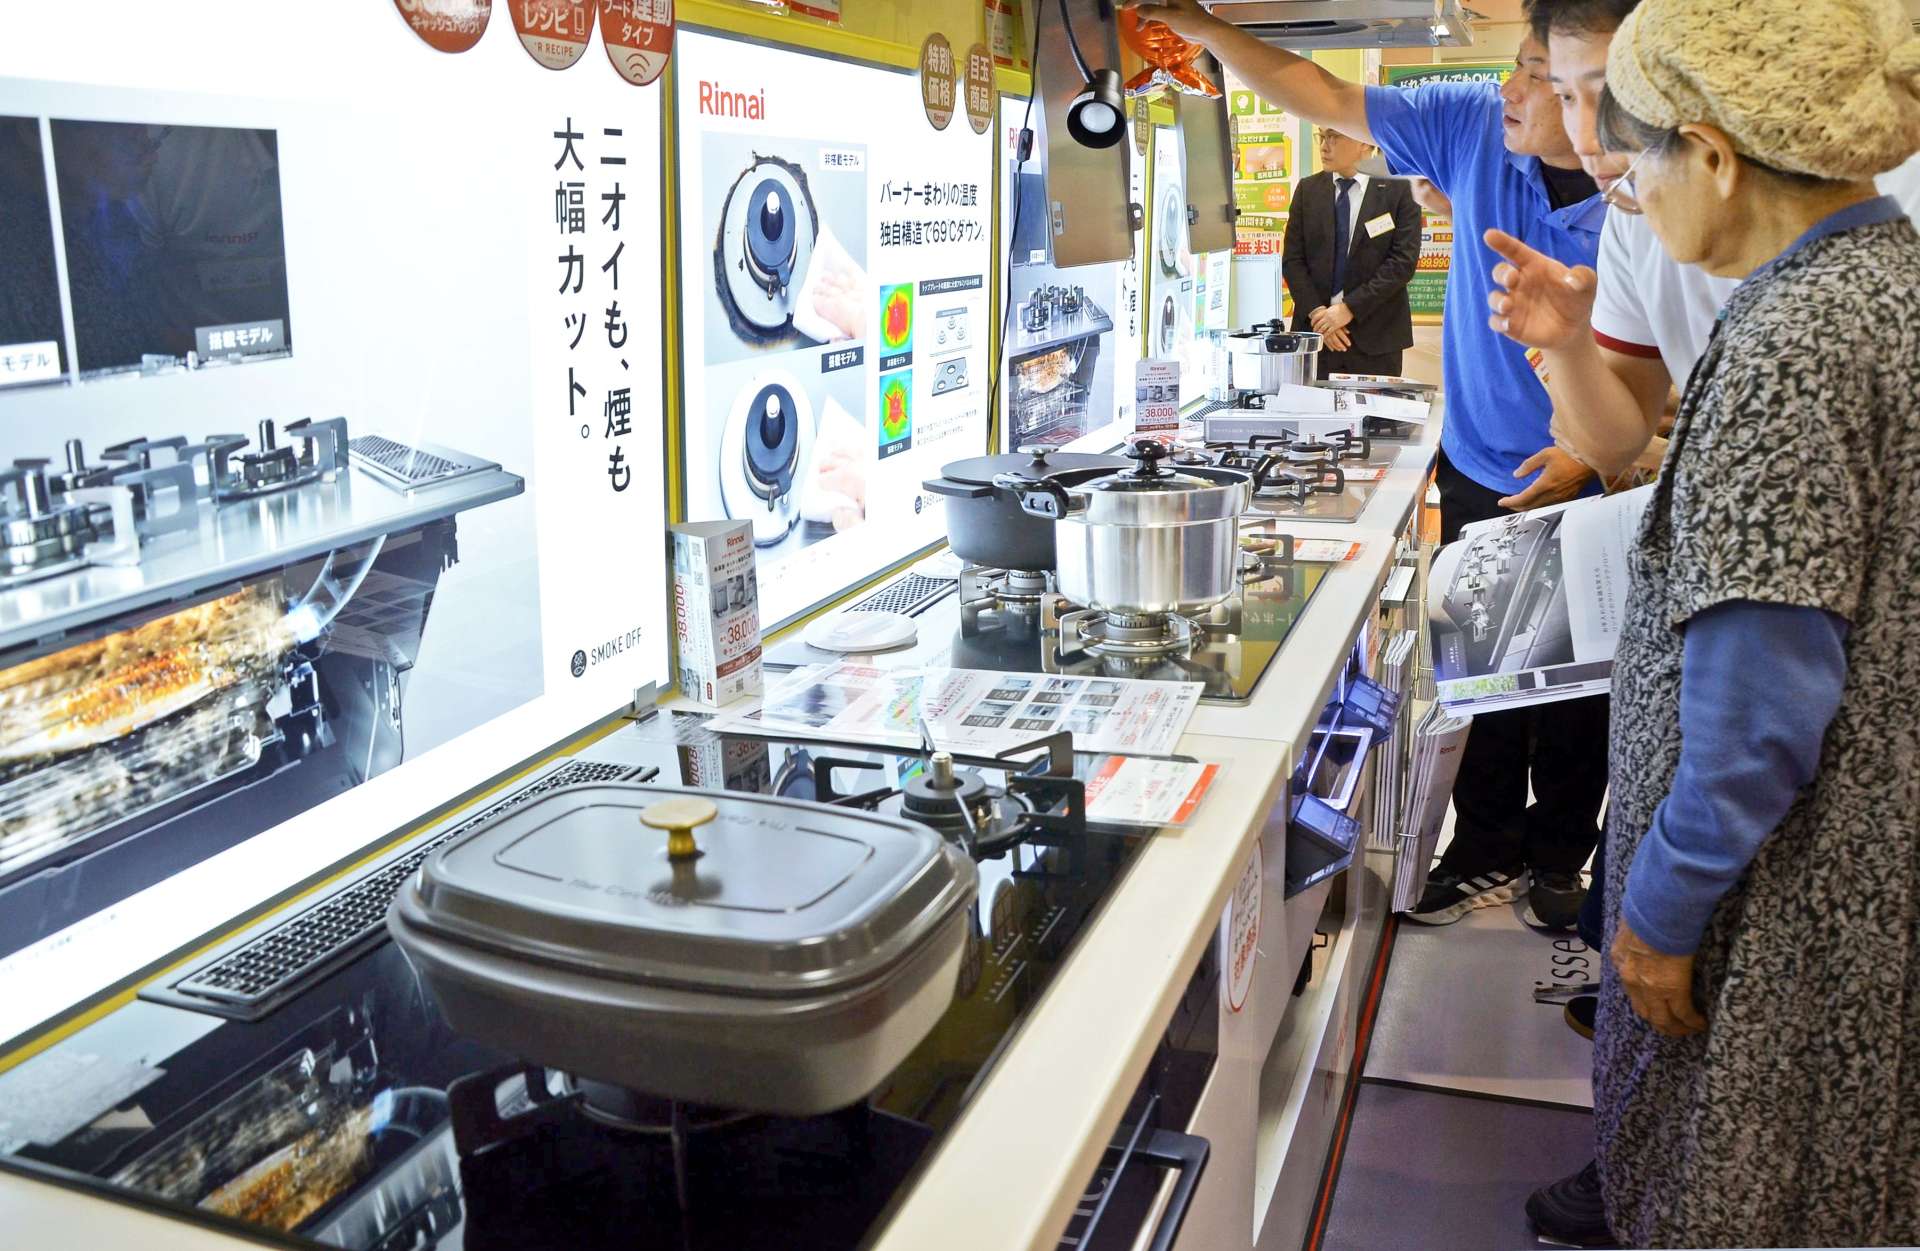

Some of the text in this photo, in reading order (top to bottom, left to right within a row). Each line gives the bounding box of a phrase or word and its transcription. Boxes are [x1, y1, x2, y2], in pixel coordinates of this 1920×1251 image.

[622, 22, 654, 46] タイプ
[546, 43, 574, 57] RECIPE
[928, 43, 950, 75] 特別
[971, 54, 990, 82] 目玉
[699, 80, 765, 120] Rinnai
[928, 76, 950, 107] 価格
[970, 85, 989, 112] 商品
[880, 179, 978, 207] バーナーまわりの温度
[553, 117, 590, 439] 大幅カット。
[600, 128, 632, 492] ニオイも、煙も
[208, 329, 273, 350] 搭載モデル
[591, 626, 643, 666] SMOKE OFF
